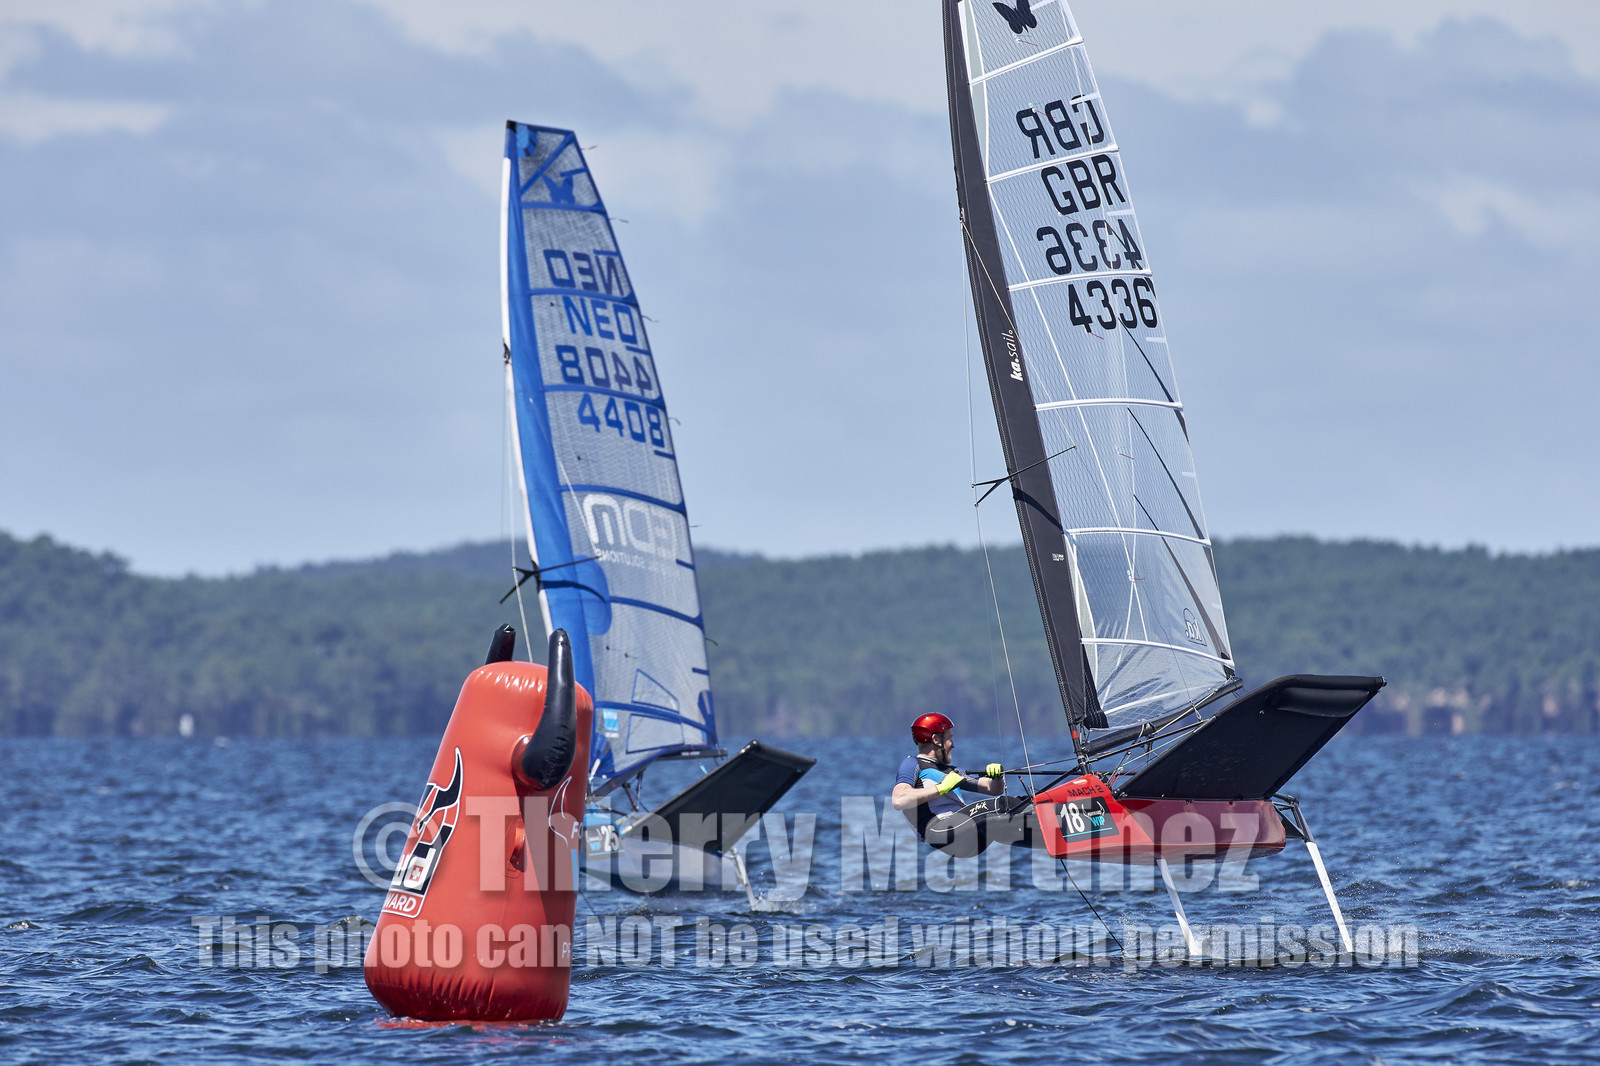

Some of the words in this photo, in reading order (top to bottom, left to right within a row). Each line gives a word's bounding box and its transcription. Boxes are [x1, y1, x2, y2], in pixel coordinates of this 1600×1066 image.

[1041, 154, 1126, 215] GBR
[563, 296, 639, 345] NED
[1068, 277, 1158, 333] 4336
[578, 394, 666, 448] 4408
[1067, 786, 1095, 797] MACH
[1095, 785, 1104, 793] 2
[600, 825, 620, 852] 25
[1061, 802, 1086, 834] 18
